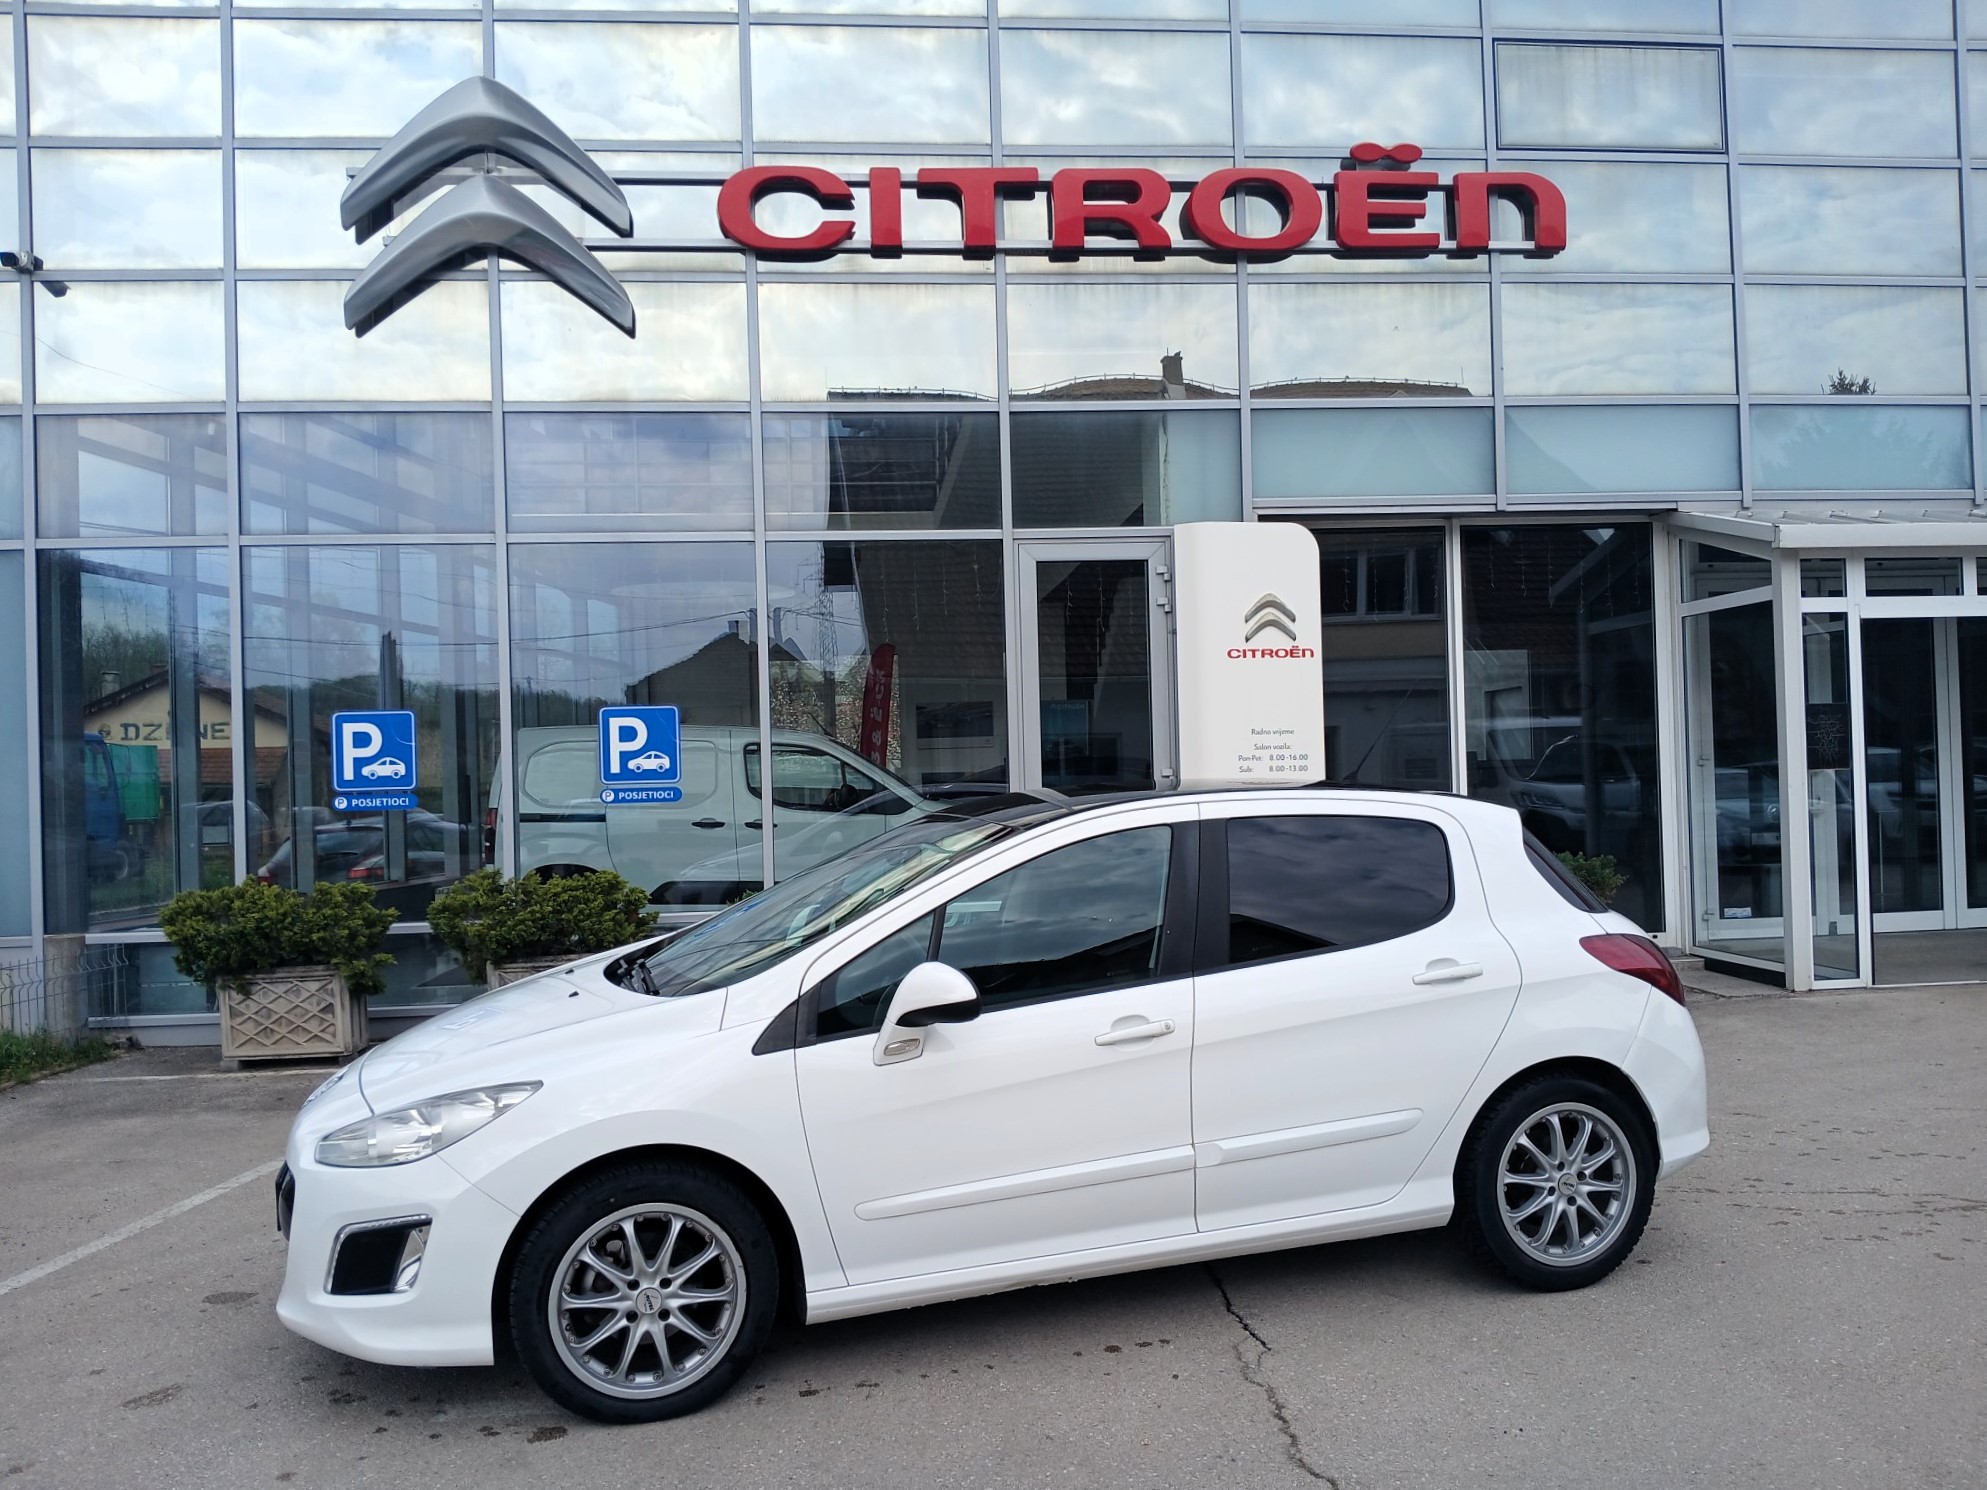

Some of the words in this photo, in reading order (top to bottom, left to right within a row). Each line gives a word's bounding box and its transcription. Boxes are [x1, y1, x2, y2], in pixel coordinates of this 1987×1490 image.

[718, 143, 1566, 257] CITROËN
[1227, 645, 1315, 659] CITROËN
[1251, 728, 1271, 736] Radno
[342, 722, 383, 781] P
[609, 717, 648, 774] P
[1254, 743, 1272, 751] Salon
[618, 790, 674, 800] POSJETIOCI
[352, 797, 409, 807] POSJETIOCI
